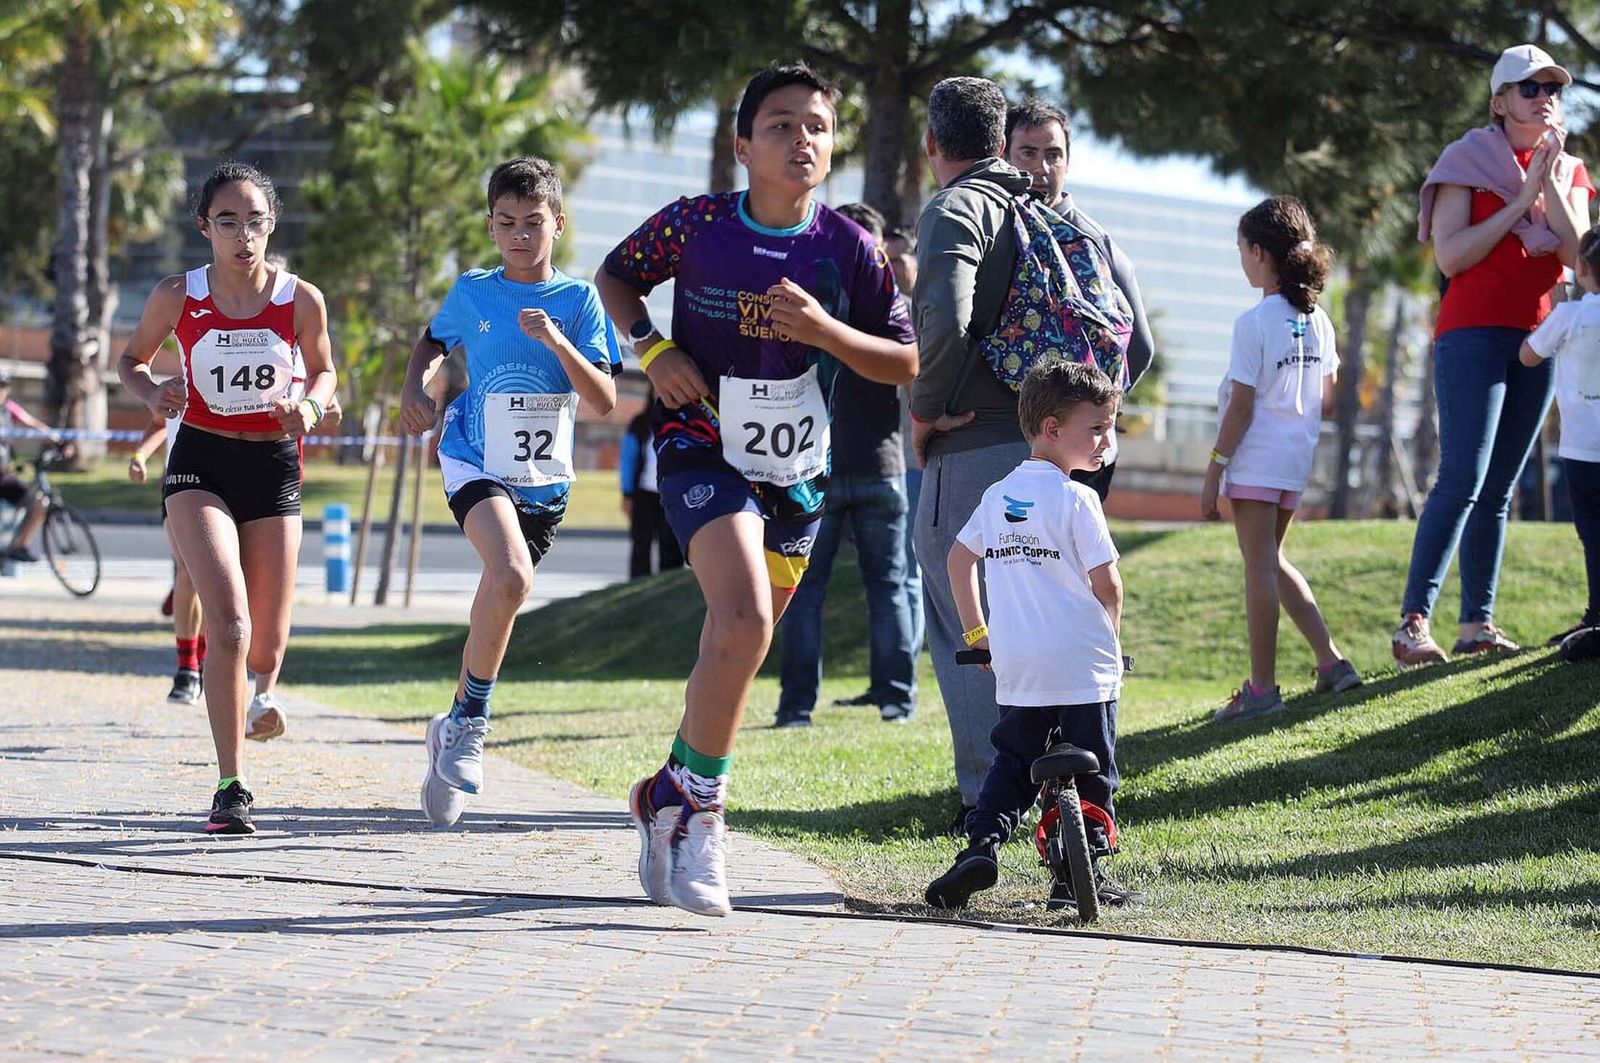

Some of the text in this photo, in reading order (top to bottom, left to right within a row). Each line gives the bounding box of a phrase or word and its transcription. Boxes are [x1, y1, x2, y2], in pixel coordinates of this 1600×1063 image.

[210, 364, 276, 393] 148
[477, 362, 549, 396] ONUBENSE
[513, 429, 553, 462] 32
[742, 415, 814, 458] 202
[1022, 545, 1061, 560] COPPER
